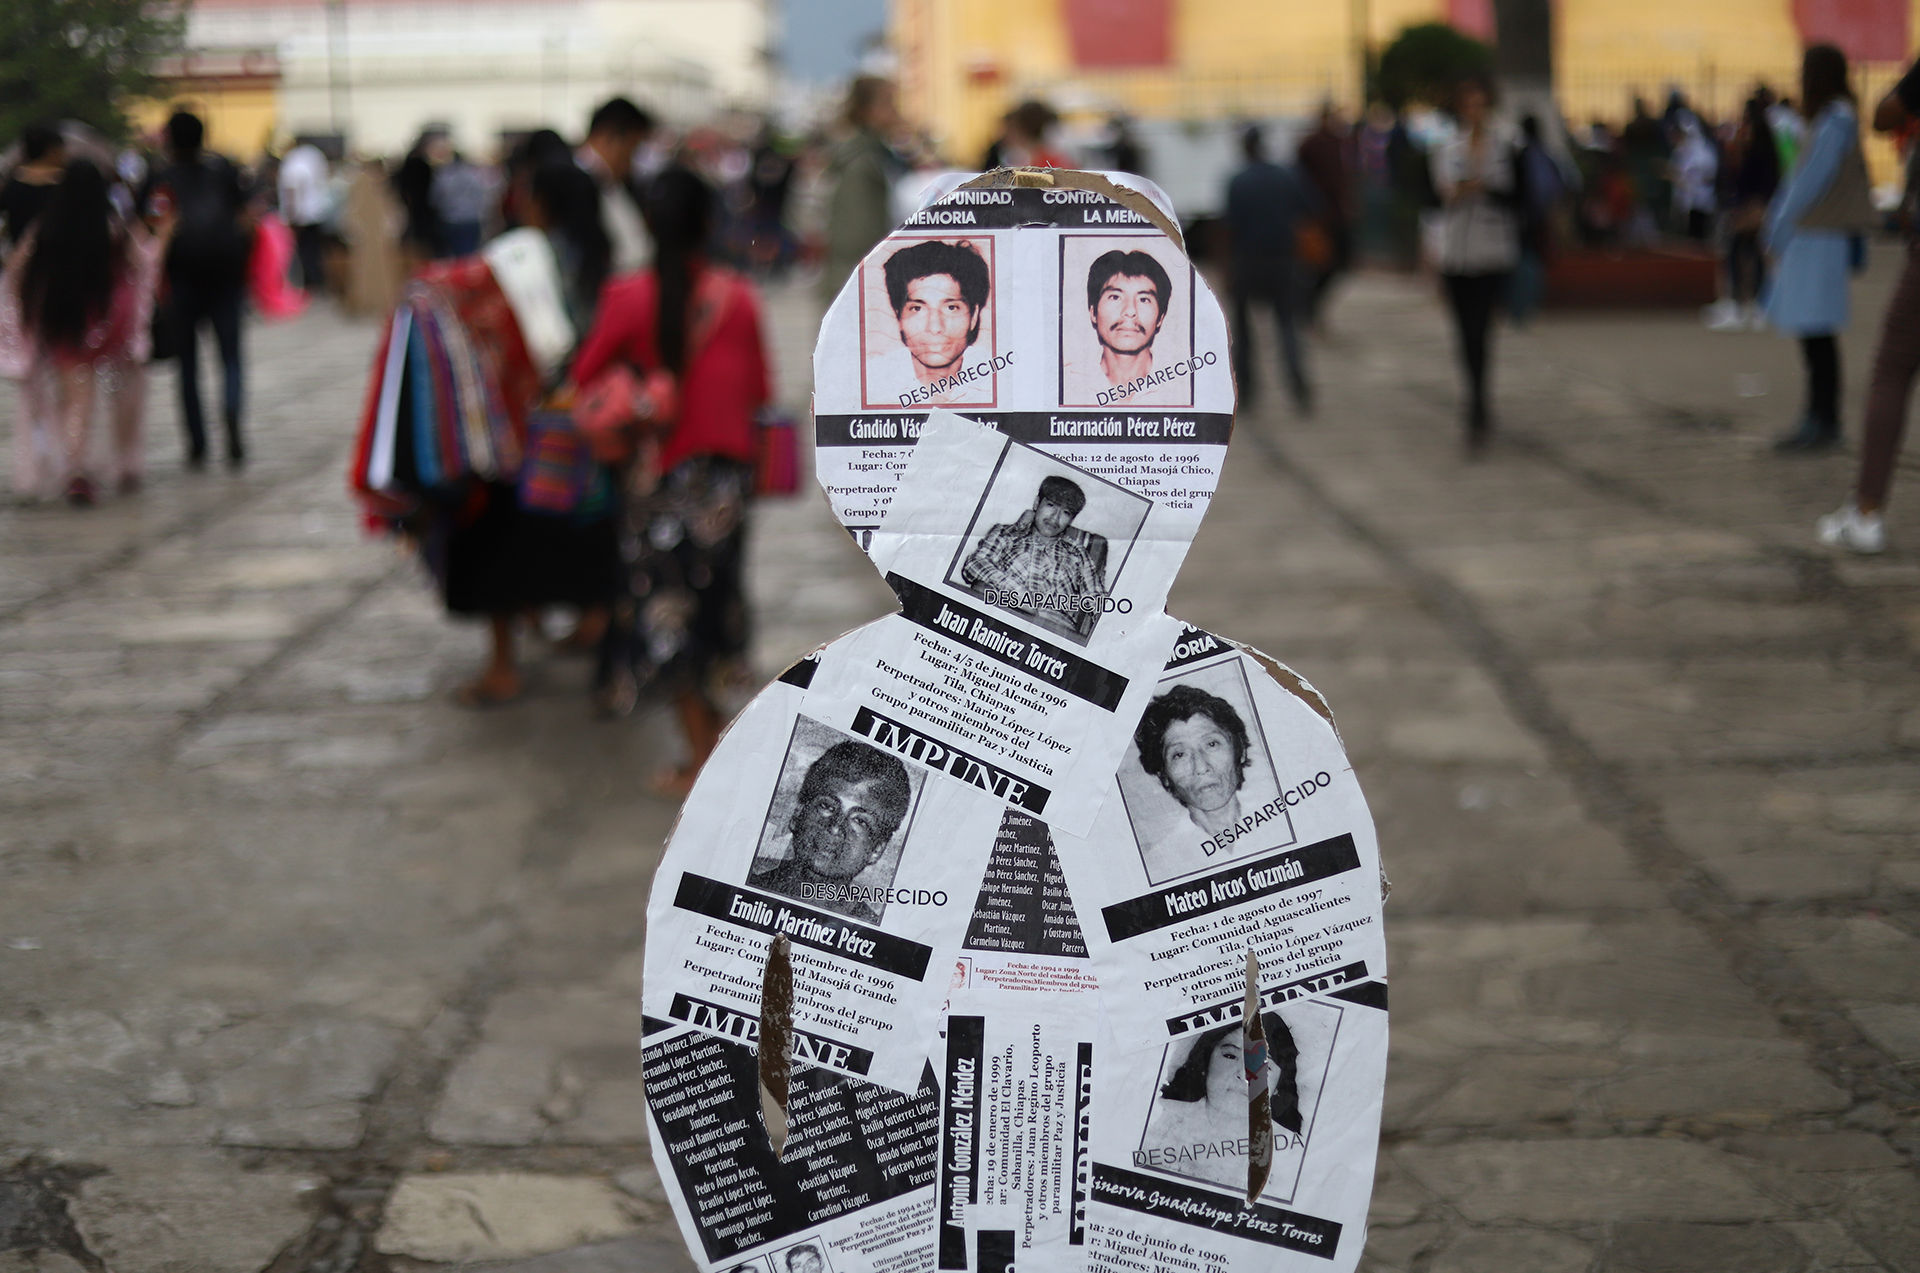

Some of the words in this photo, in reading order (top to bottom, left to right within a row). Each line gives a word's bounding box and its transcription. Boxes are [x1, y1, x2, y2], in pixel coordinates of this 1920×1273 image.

[1084, 210, 1102, 223] LA
[1096, 351, 1217, 406] DESAPARECIDO
[849, 418, 897, 439] Cándido
[1050, 416, 1122, 437] Encarnación
[1127, 416, 1159, 437] Pérez
[1163, 417, 1196, 437] Pérez
[848, 462, 883, 472] Lugar:
[862, 450, 897, 459] Fecha:
[1091, 454, 1101, 462] 12
[1104, 453, 1117, 462] de
[1119, 454, 1155, 464] agosto
[1159, 453, 1173, 462] de
[1175, 454, 1200, 464] 1996
[1140, 465, 1178, 476] Masojá
[1181, 465, 1214, 476] Chico,
[1117, 477, 1161, 487] Chiapas
[1170, 489, 1187, 497] del
[844, 509, 878, 519] Grupo
[873, 498, 879, 506] y
[984, 590, 1133, 614] DESAPARECIDO
[932, 603, 969, 636] Juan
[967, 617, 1025, 661] Ramirez
[1024, 642, 1068, 680] Torres
[913, 632, 952, 657] Fecha:
[952, 653, 974, 668] 4/5
[975, 660, 990, 673] de
[988, 666, 1022, 688] junio
[1023, 682, 1038, 696] de
[1040, 691, 1067, 708] 1996
[919, 649, 959, 674] Lugar:
[959, 667, 1001, 693] Miguel
[1000, 687, 1048, 716] Alemán,
[876, 659, 962, 705] Perpetradores:
[963, 698, 999, 722] Mario
[1000, 715, 1036, 737] López
[1036, 732, 1072, 754] López
[943, 674, 967, 694] Tila,
[970, 687, 1017, 715] Chiapas
[871, 687, 908, 710] Grupo
[908, 706, 977, 740] paramilitar
[977, 734, 999, 750] Paz
[998, 746, 1008, 756] y
[1008, 749, 1053, 776] Justicia
[907, 691, 918, 701] y
[918, 695, 949, 714] otros
[950, 710, 1008, 741] miembros
[1010, 735, 1030, 750] del
[865, 715, 1029, 806] IMPUNE
[1200, 771, 1331, 857] DESAPARECIDO
[800, 883, 948, 907] DESAPARECIDO
[1164, 889, 1208, 917] Mateo
[1210, 876, 1247, 904] Arcos
[1247, 857, 1305, 891] Guzmán
[729, 893, 774, 926] Emilio
[774, 907, 837, 946] Martínez
[836, 926, 877, 959] Pérez
[1150, 944, 1190, 962] Lugar:
[1191, 920, 1261, 949] Comunidad
[1263, 896, 1351, 928] Aguascalientes
[1170, 924, 1210, 942] Fecha:
[1213, 921, 1218, 929] 1
[1220, 915, 1235, 926] de
[1237, 904, 1276, 922] agosto
[1278, 897, 1293, 909] de
[1296, 889, 1323, 903] 1997
[706, 924, 745, 944] Fecha:
[748, 939, 762, 949] 10
[849, 968, 865, 980] de
[867, 976, 895, 990] 1996
[1144, 959, 1233, 991] Perpetradores:
[1285, 932, 1320, 948] López
[1322, 916, 1371, 936] Vázquez
[1216, 941, 1245, 955] Tila,
[1246, 927, 1294, 946] Chiapas
[695, 936, 735, 955] Lugar:
[807, 970, 851, 991] Masojá
[853, 984, 897, 1005] Grande
[1181, 986, 1188, 997] y
[1190, 977, 1223, 991] otros
[1286, 947, 1306, 962] del
[1307, 939, 1343, 958] grupo
[1261, 971, 1282, 983] Paz
[1284, 968, 1292, 979] y
[1294, 952, 1342, 973] Justicia
[802, 1011, 811, 1021] y
[812, 1013, 859, 1035] Justicia
[837, 1006, 857, 1020] del
[856, 1015, 893, 1031] grupo
[991, 1056, 1001, 1083] 1999
[1029, 1023, 1042, 1079] Leoporto
[951, 1057, 976, 1109] Méndez
[1001, 1044, 1014, 1098] Clavario,
[1044, 1055, 1055, 1092] grupo
[1054, 1062, 1066, 1109] Justicia
[987, 1087, 999, 1102] de
[1000, 1101, 1011, 1113] El
[1013, 1079, 1027, 1128] Chiapas
[1027, 1082, 1040, 1124] Regino
[1041, 1094, 1051, 1113] del
[989, 1104, 998, 1140] enero
[1053, 1120, 1064, 1142] Paz
[948, 1112, 973, 1172] González
[985, 1141, 996, 1157] de
[998, 1116, 1011, 1186] Comunidad
[1011, 1131, 1023, 1191] Sabanilla,
[1026, 1127, 1037, 1157] Juan
[1039, 1115, 1050, 1176] miembros
[987, 1159, 997, 1171] 19
[1051, 1144, 1062, 1214] paramilitar
[1021, 1160, 1035, 1249] Perpetradores:
[1038, 1178, 1048, 1211] otros
[1039, 1213, 1049, 1221] y
[1145, 1190, 1233, 1228] Guadalupe
[1233, 1211, 1279, 1234] Pérez
[1281, 1223, 1324, 1245] Torres
[1104, 1238, 1148, 1258] Miguel
[1107, 1227, 1124, 1238] 20
[1126, 1230, 1142, 1242] de
[1141, 1233, 1177, 1251] junio
[1179, 1243, 1195, 1256] de
[1198, 1250, 1230, 1265] 1996.
